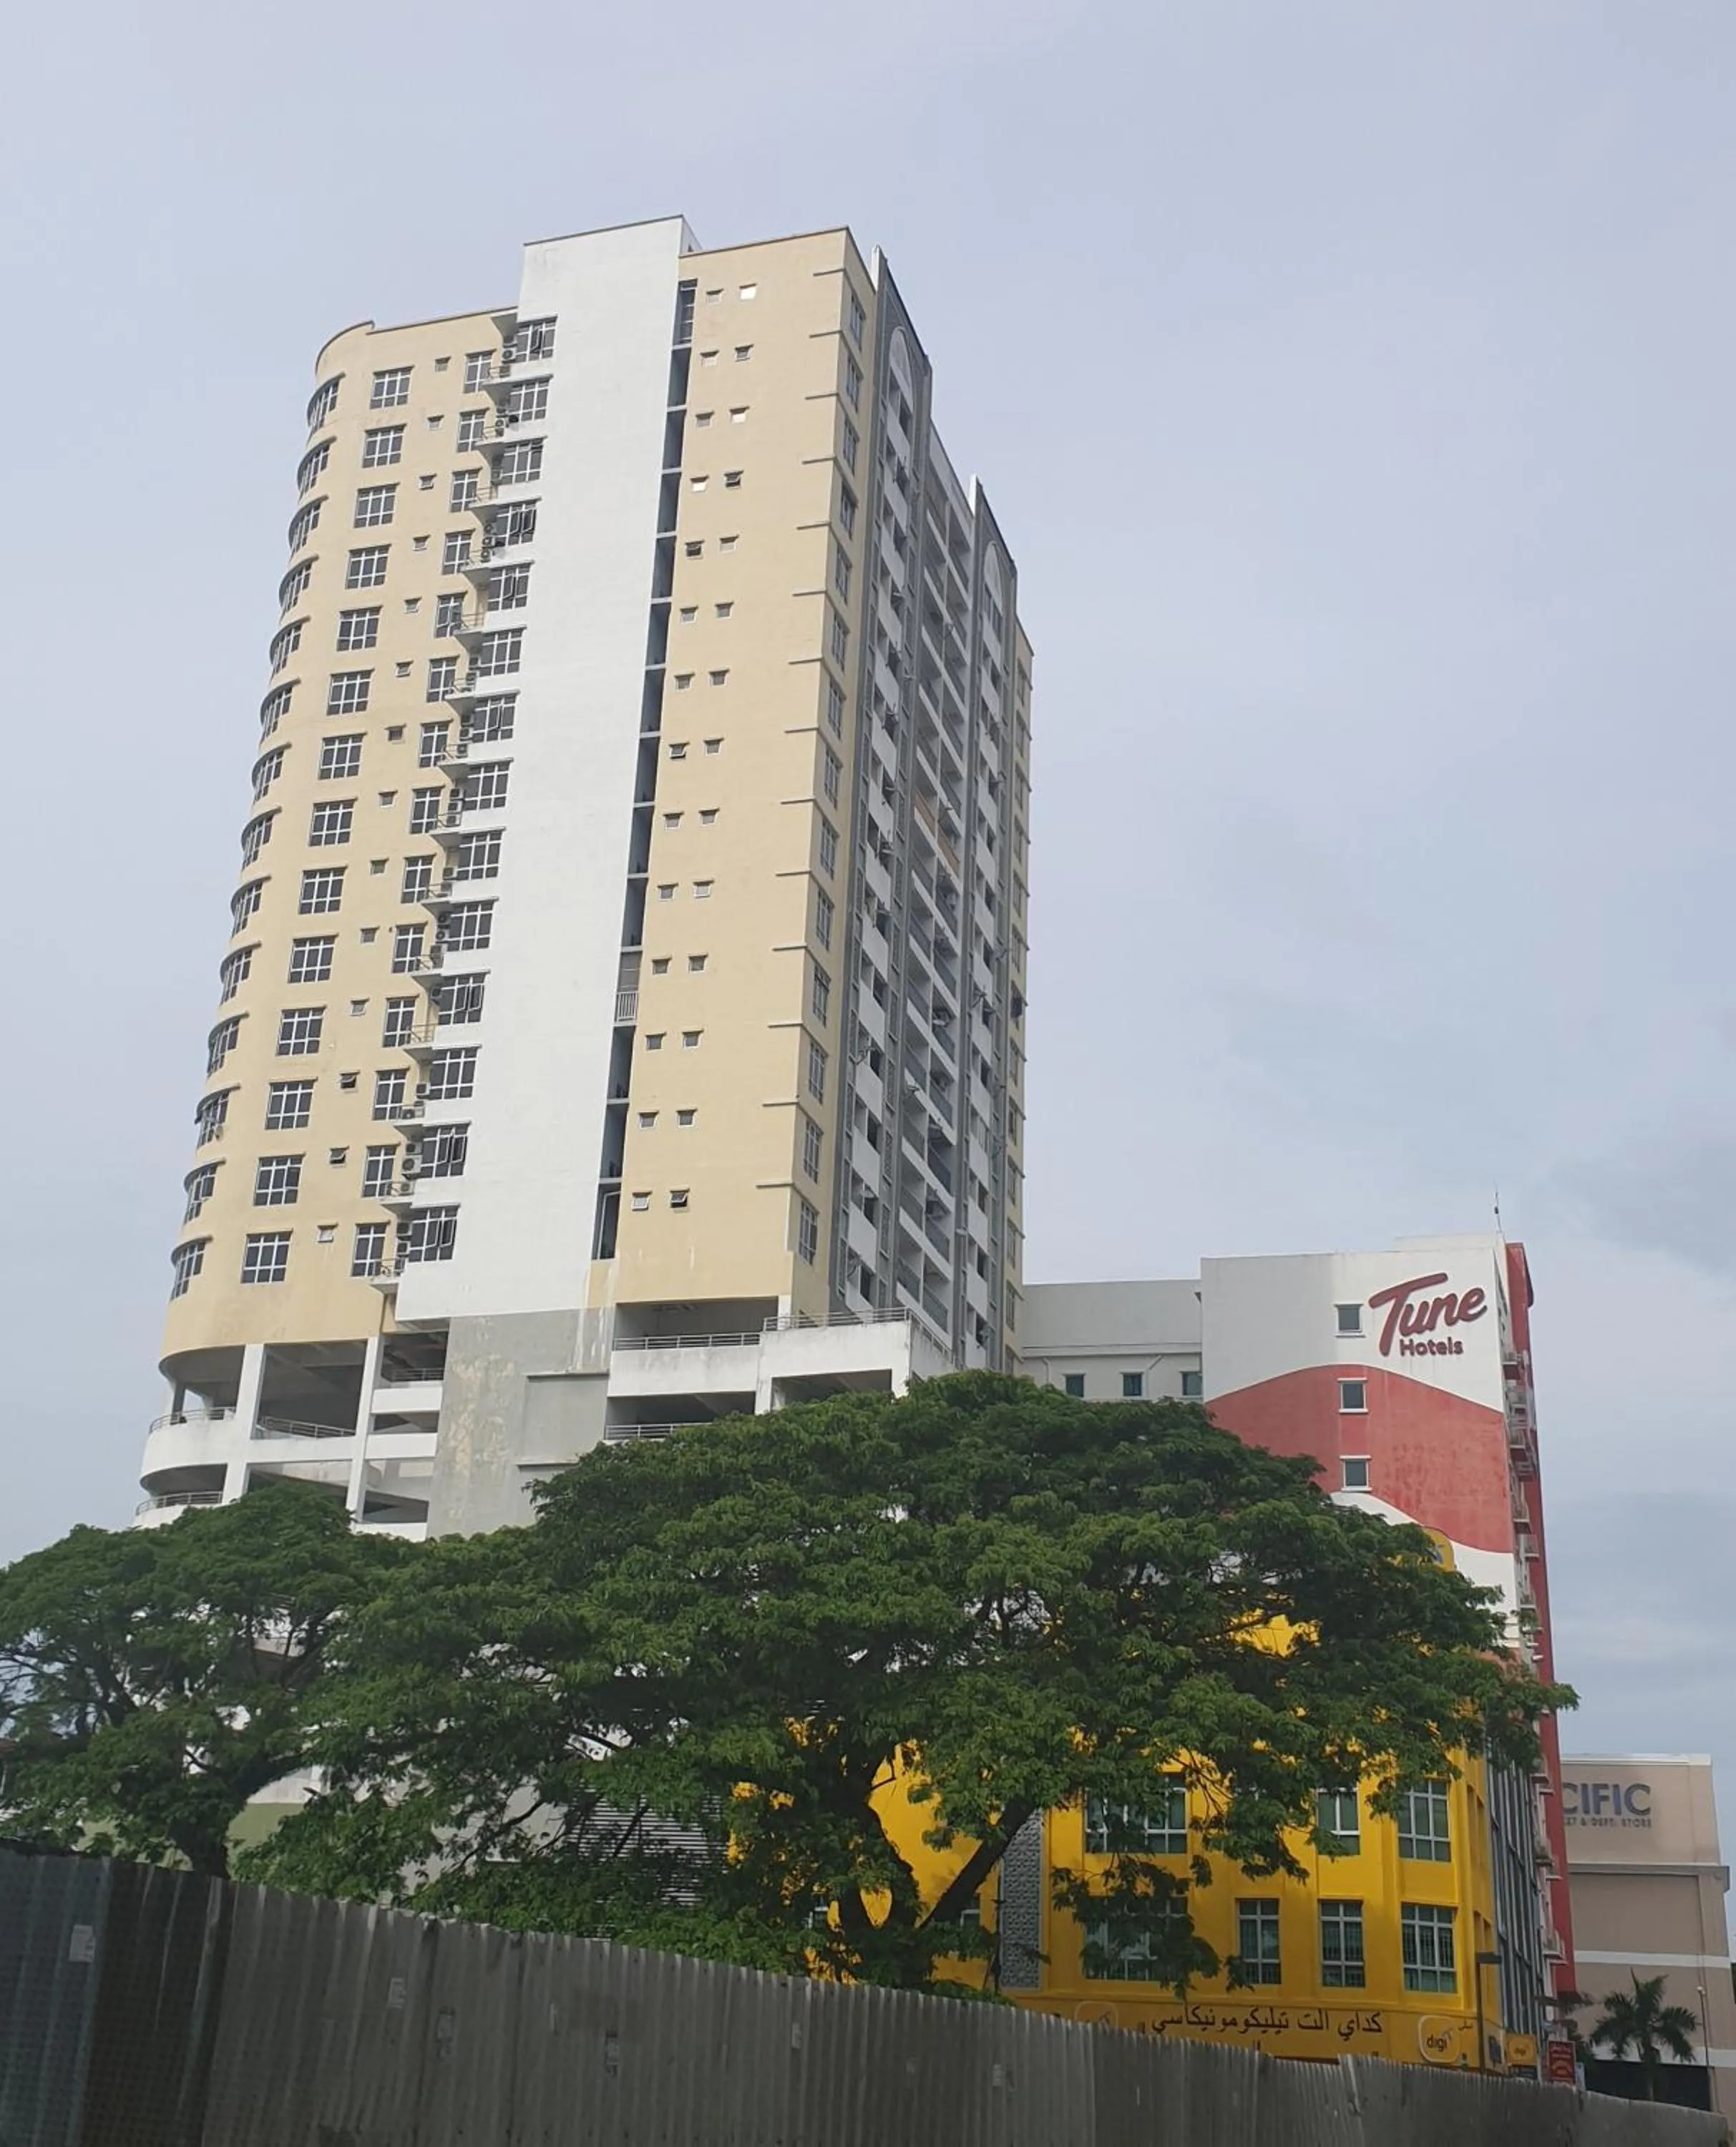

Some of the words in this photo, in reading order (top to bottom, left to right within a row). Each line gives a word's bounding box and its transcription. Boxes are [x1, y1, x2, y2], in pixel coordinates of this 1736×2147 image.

[1368, 1272, 1488, 1357] Tune
[1400, 1337, 1464, 1357] Hotels
[1426, 2033, 1448, 2052] digi
